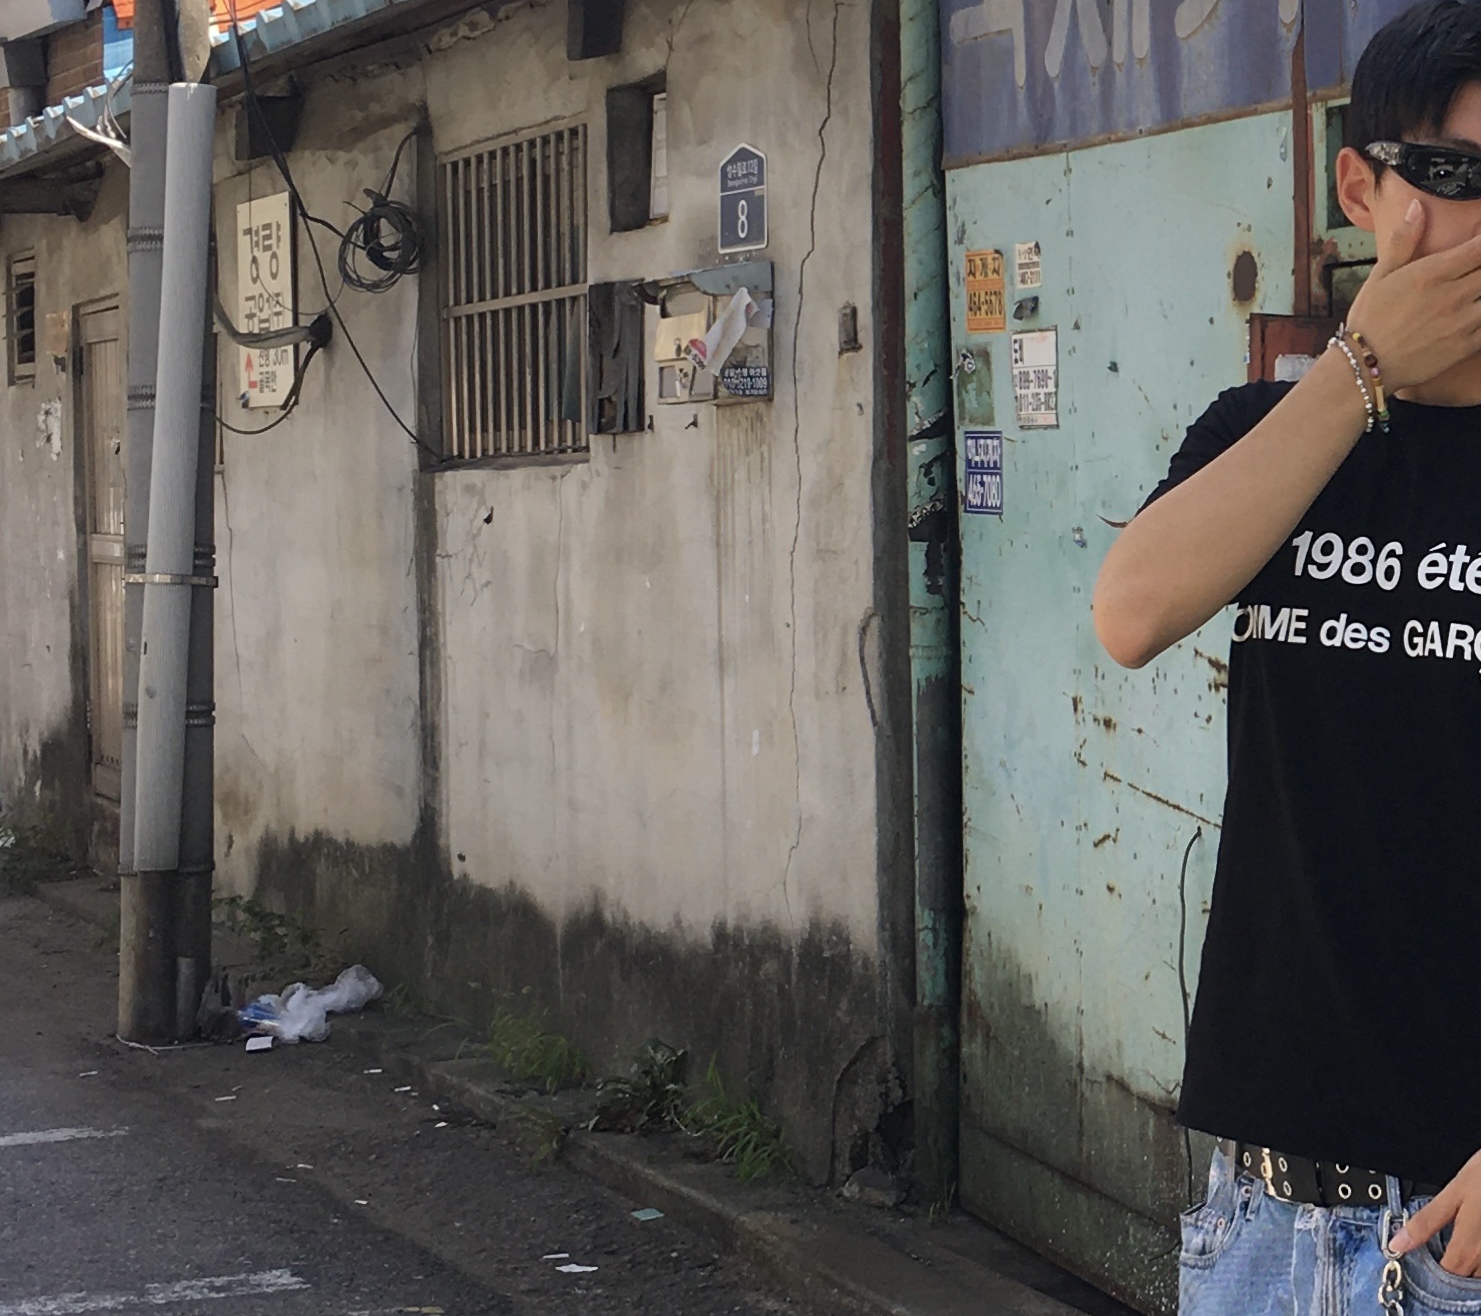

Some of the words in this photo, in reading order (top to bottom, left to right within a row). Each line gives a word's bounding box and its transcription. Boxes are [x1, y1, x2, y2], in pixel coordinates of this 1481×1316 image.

[737, 199, 749, 239] 8
[242, 220, 282, 285] 경량
[1291, 530, 1403, 591] 1986
[1319, 613, 1391, 654] des
